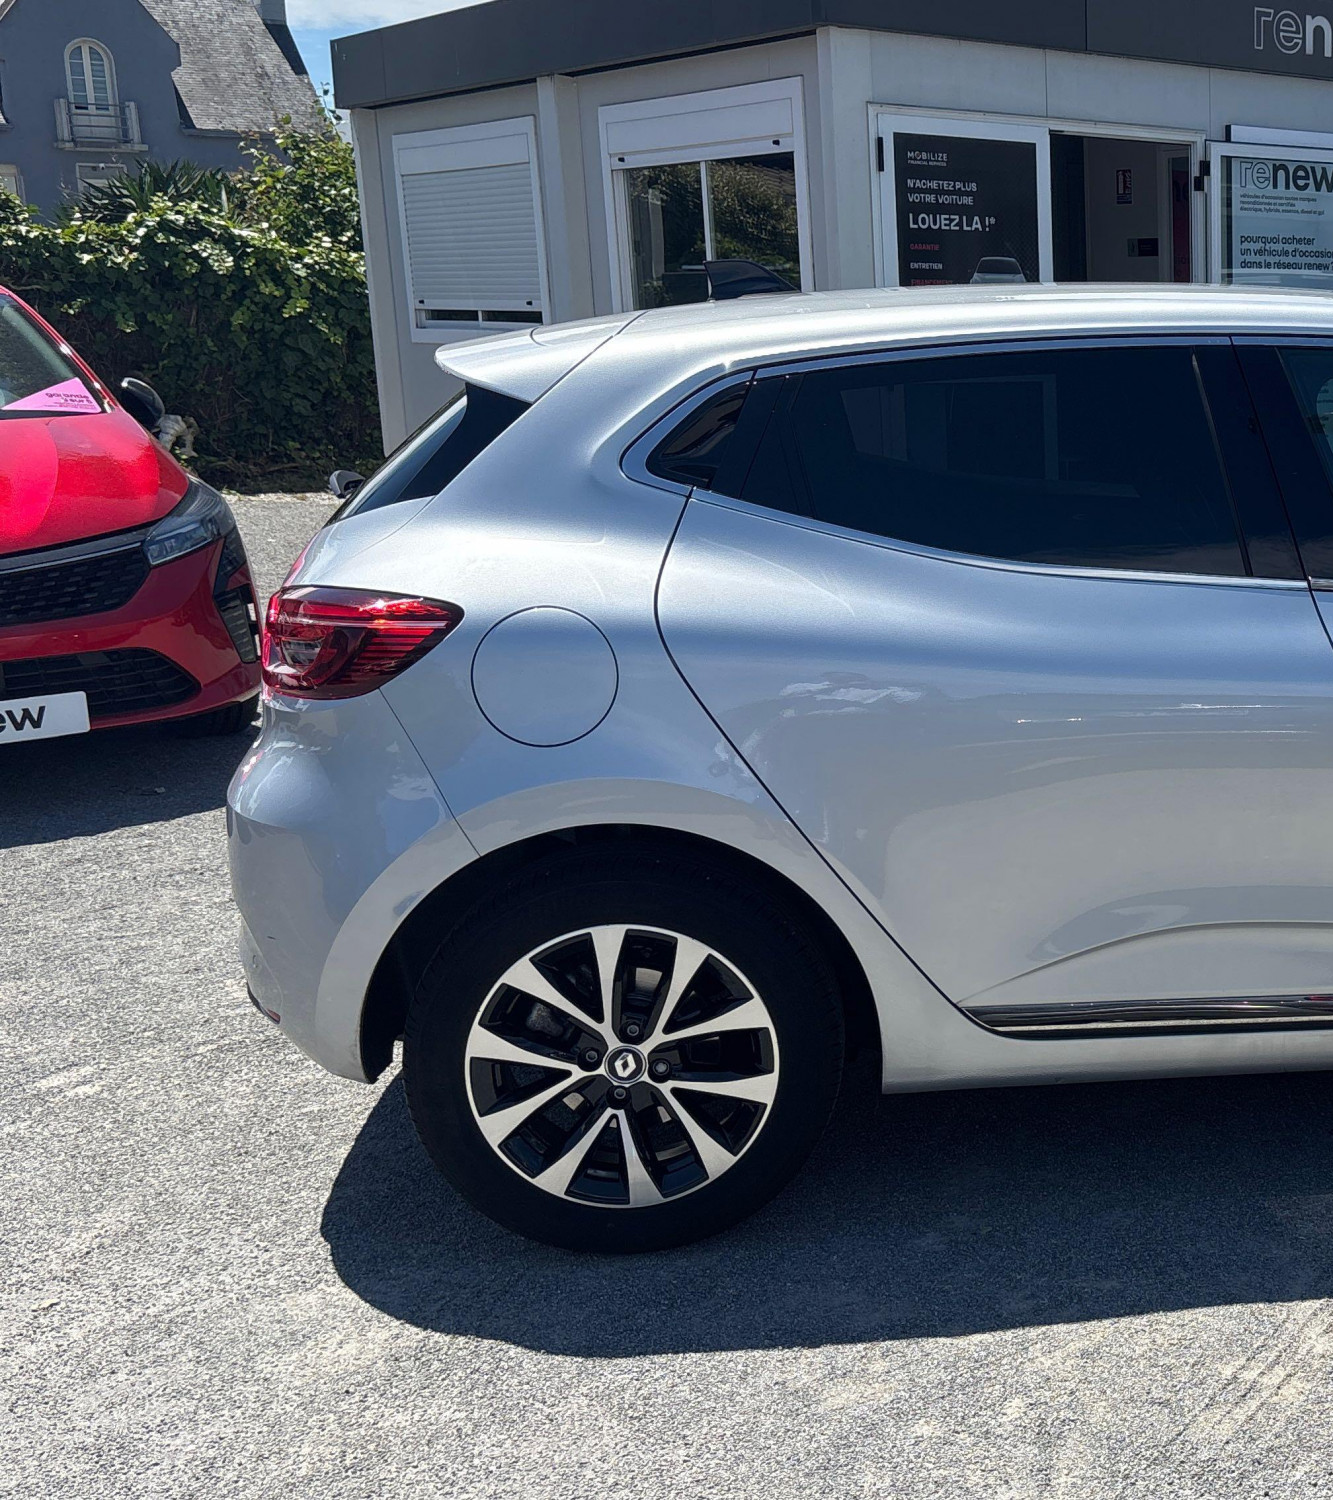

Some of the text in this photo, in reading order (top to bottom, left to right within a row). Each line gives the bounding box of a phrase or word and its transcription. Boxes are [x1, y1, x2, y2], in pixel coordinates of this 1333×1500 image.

[907, 151, 948, 161] MOBILIZE
[907, 179, 977, 191] N'ACHETEZ PLUS
[907, 193, 974, 205] VOTRE VOITURE
[909, 213, 960, 230] LOUEZ
[962, 215, 982, 231] LA
[1240, 234, 1315, 246] pourquoi acheter
[1240, 248, 1251, 256] un
[1253, 246, 1289, 257] véhicule
[910, 262, 942, 270] ENTRETIEN
[1240, 259, 1262, 269] dans
[1264, 259, 1272, 269] le
[1273, 260, 1302, 270] réseau
